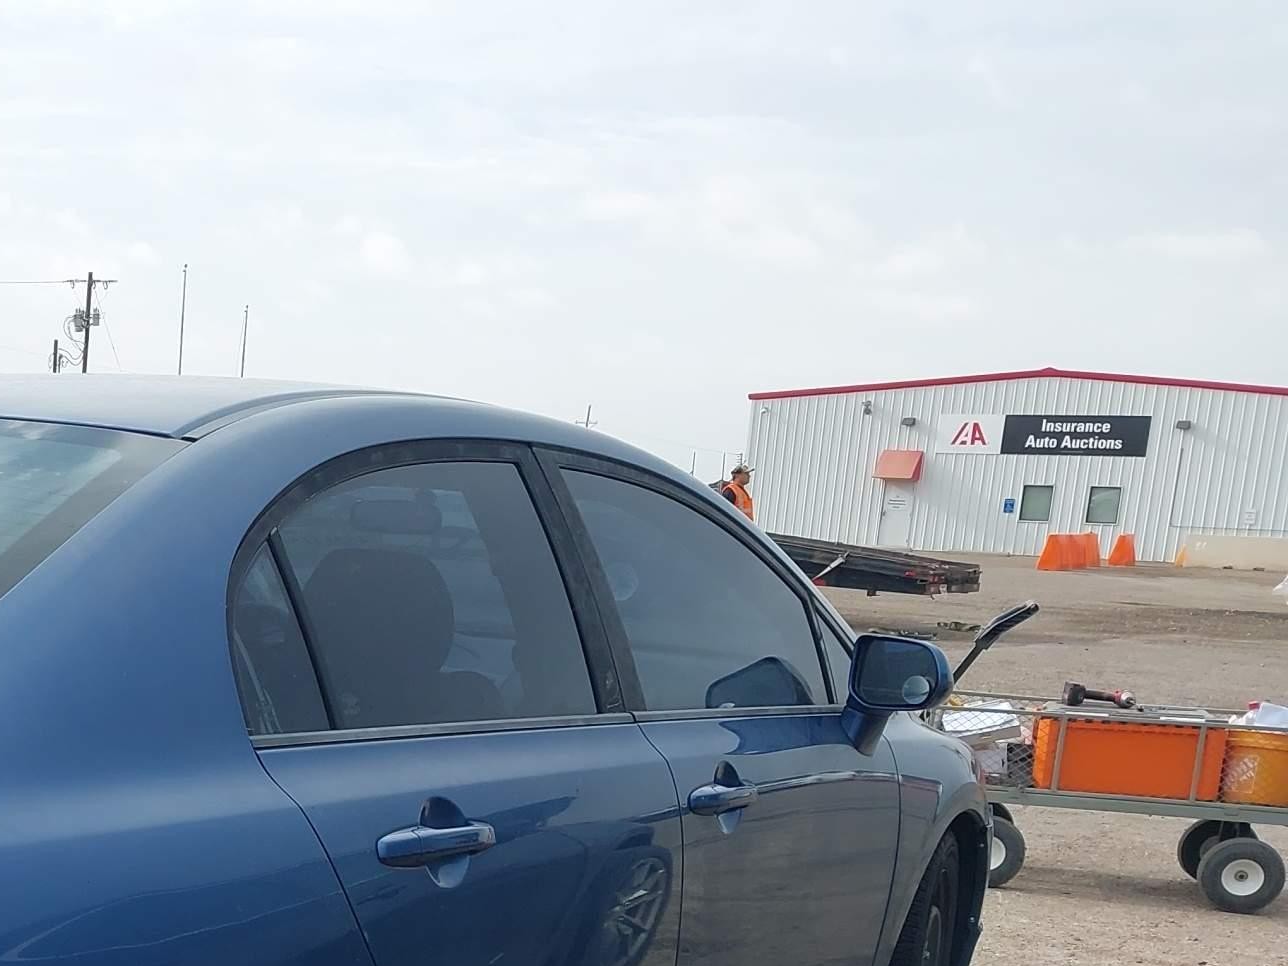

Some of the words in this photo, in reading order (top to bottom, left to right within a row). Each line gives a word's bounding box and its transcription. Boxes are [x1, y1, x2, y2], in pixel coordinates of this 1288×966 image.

[1041, 418, 1111, 433] Insurance
[1024, 434, 1058, 449] Auto
[1059, 435, 1123, 450] Auctions
